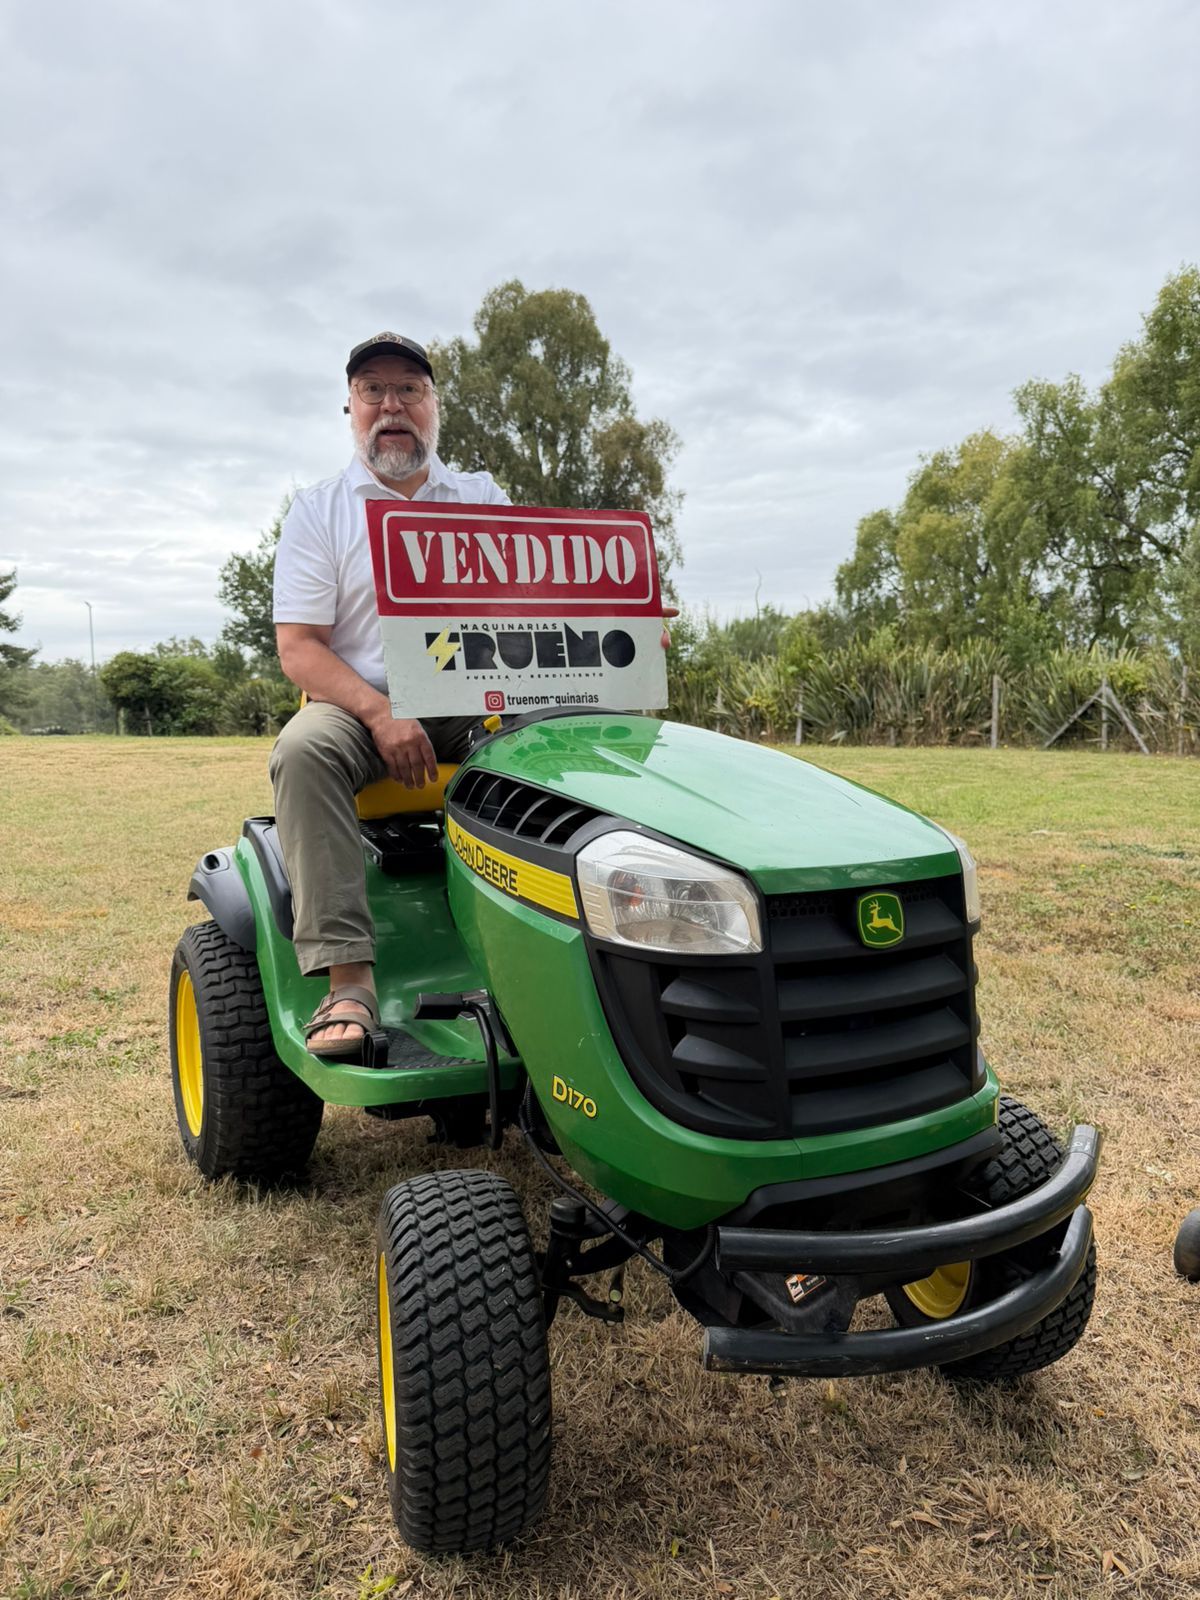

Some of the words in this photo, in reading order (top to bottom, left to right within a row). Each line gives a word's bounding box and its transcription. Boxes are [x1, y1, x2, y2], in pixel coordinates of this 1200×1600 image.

[400, 530, 637, 585] VENDIDO
[425, 622, 636, 672] TRUENO
[460, 622, 558, 631] MAQUINARIAS
[455, 826, 475, 867] JOHN
[475, 845, 518, 893] DEERE
[552, 1074, 598, 1118] D170
